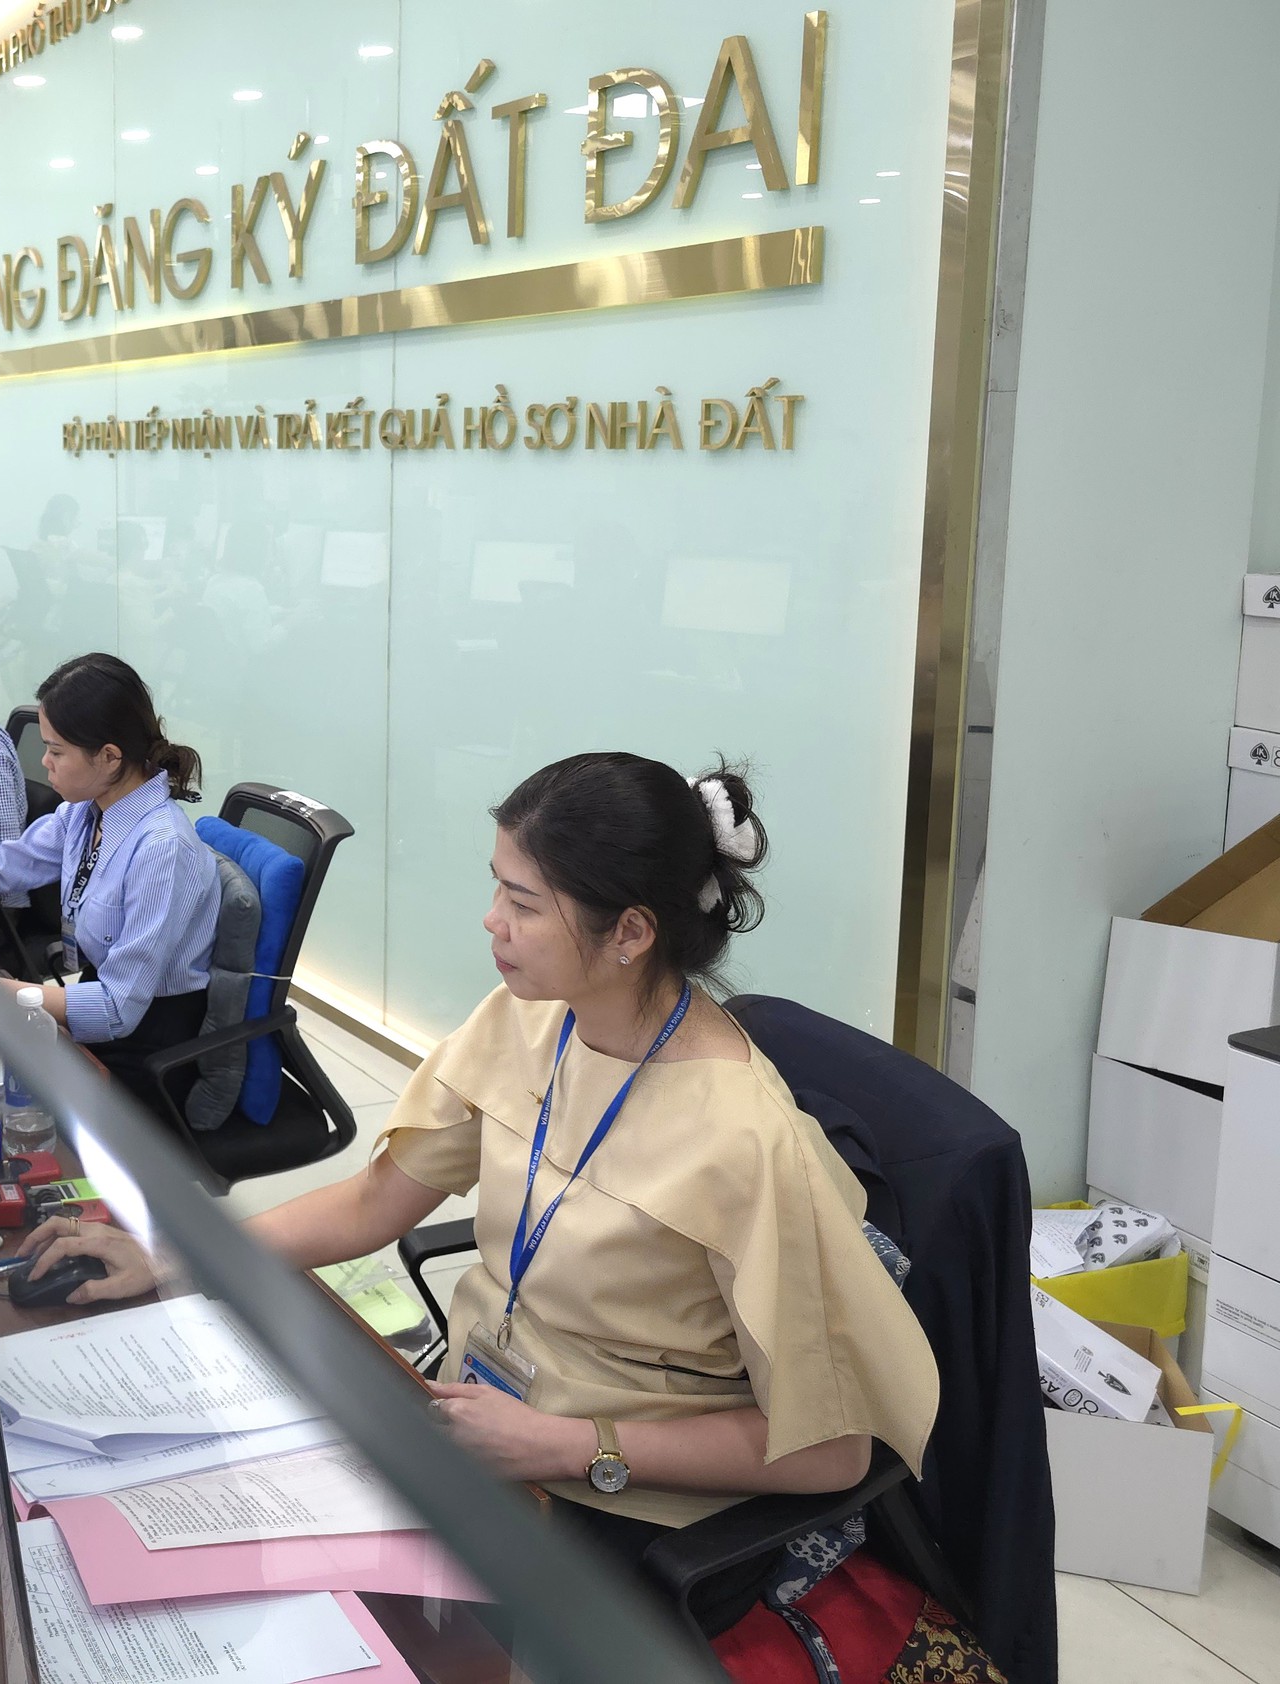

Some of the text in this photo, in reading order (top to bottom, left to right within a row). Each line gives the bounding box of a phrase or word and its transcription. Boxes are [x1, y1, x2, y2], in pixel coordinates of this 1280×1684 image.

[10, 2, 46, 68] PHỐ
[57, 202, 213, 322] ĐĂNG
[230, 131, 327, 290] KÝ
[352, 58, 548, 266] ĐẤT
[580, 9, 828, 225] ĐAI
[86, 414, 131, 459] PHẬN
[133, 405, 171, 450] TIẾP
[172, 408, 233, 459] NHẬN
[234, 405, 272, 450] VÀ
[273, 399, 322, 450] TRẢ
[326, 396, 376, 450] KẾT
[379, 392, 456, 450] QUẢ
[463, 384, 519, 451] HỒ
[524, 396, 579, 451] SƠ
[585, 385, 684, 451] NHÀ
[698, 377, 806, 452] ĐẤT
[1040, 1375, 1061, 1393] A4
